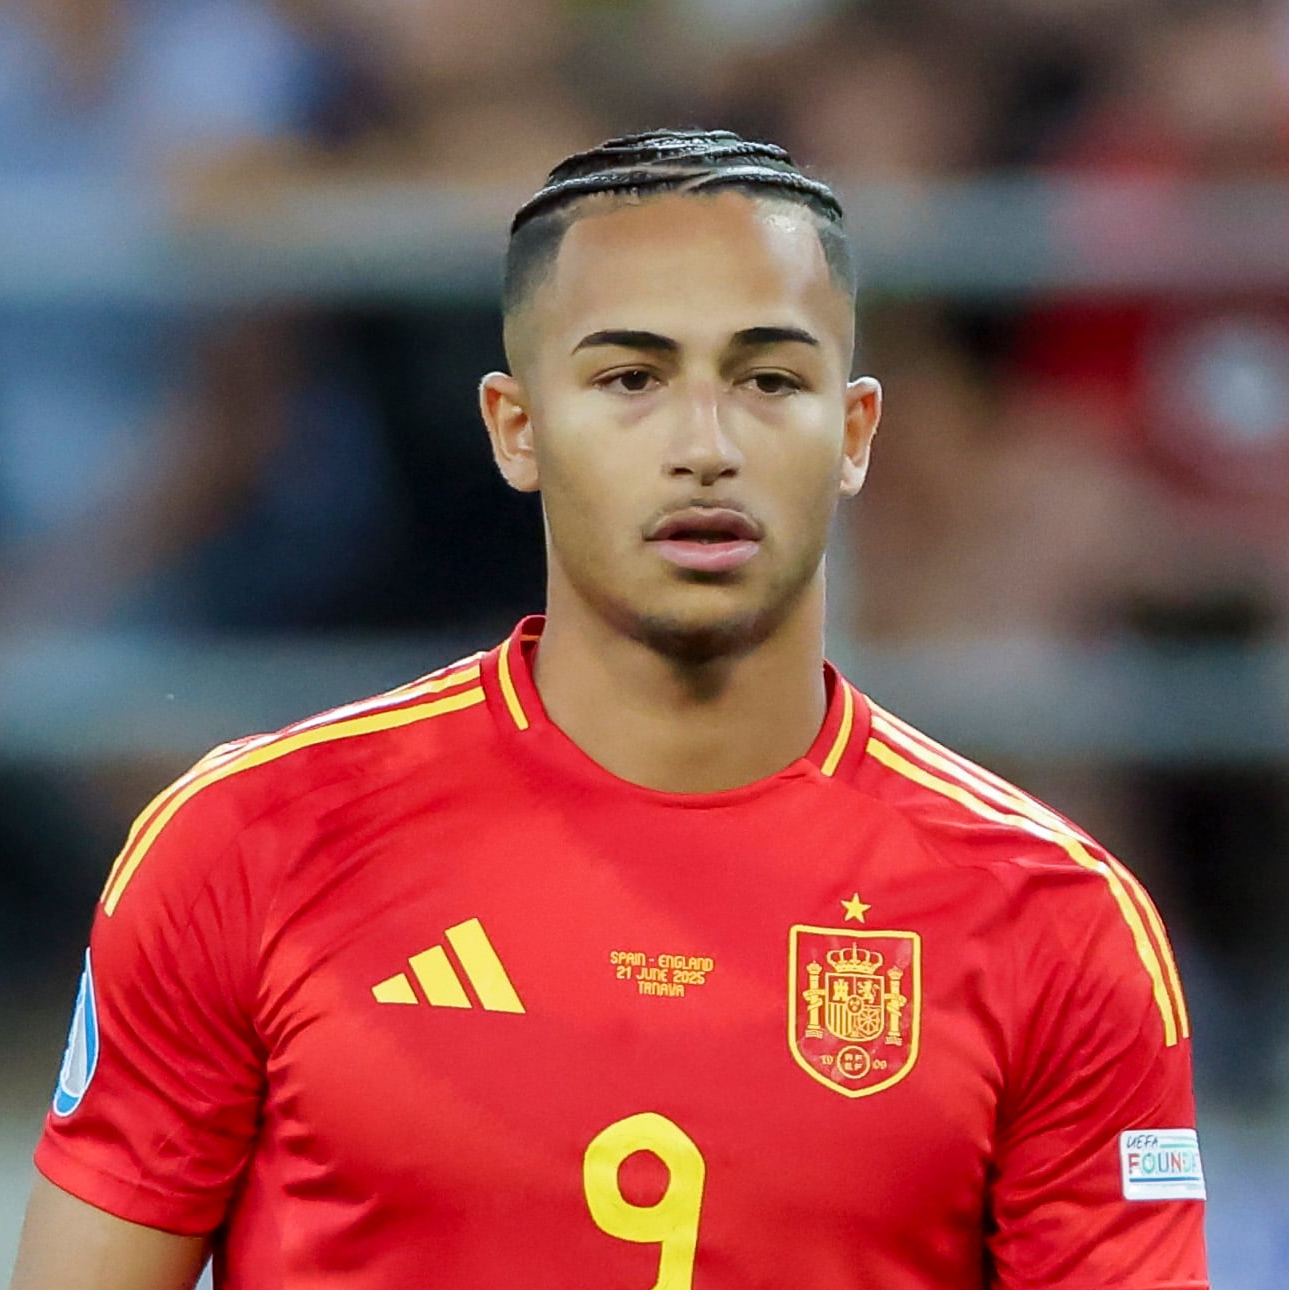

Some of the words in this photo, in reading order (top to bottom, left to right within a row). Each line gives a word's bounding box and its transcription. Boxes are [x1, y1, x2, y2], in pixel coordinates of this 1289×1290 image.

[610, 951, 646, 966] SPAIN
[658, 954, 714, 972] ENGLAND
[616, 965, 632, 979] 21
[636, 967, 668, 982] JUNE
[673, 970, 705, 984] 2025
[1127, 1134, 1158, 1149] UEFA
